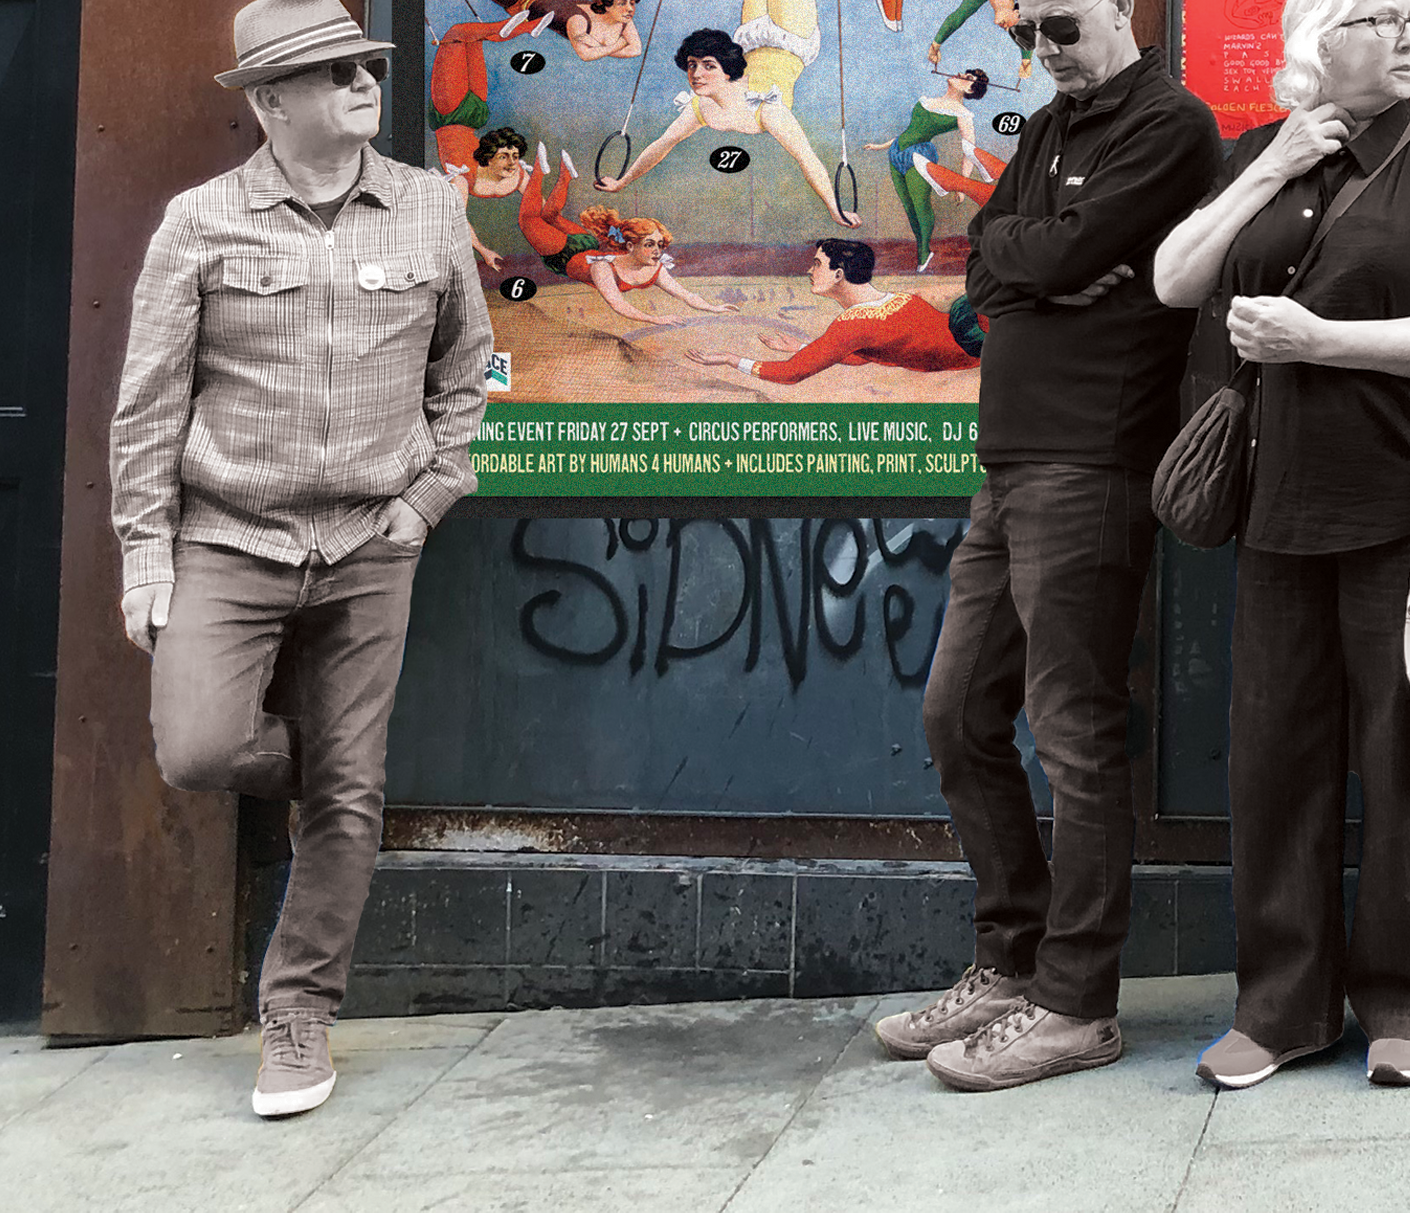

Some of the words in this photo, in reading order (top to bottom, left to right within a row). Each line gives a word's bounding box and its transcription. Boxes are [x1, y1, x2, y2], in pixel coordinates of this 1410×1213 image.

[519, 52, 536, 73] 7
[1224, 68, 1239, 76] SEX
[1250, 60, 1270, 68] GOOD
[1206, 102, 1246, 112] OLDEN
[998, 114, 1021, 133] 69
[716, 150, 743, 169] 27
[510, 278, 526, 298] 6
[508, 421, 555, 441] EVENT
[558, 421, 605, 441] FRIDAY
[610, 421, 626, 441] 27
[631, 421, 669, 441] SEPT
[689, 421, 739, 441] CIRCUS
[743, 421, 842, 443] PERFORMERS,
[849, 421, 879, 441] LIVE
[883, 421, 932, 443] MUSIC,
[943, 421, 962, 441] DJ
[469, 453, 534, 473] ORDABLE
[538, 453, 565, 473] ART
[569, 453, 585, 473] BY
[590, 453, 648, 473] HUMANS
[651, 453, 660, 473] 4
[663, 453, 720, 473] HUMANS
[736, 453, 804, 473] INCLUDES
[807, 453, 874, 475] PAINTING,
[877, 453, 922, 475] PRINT,
